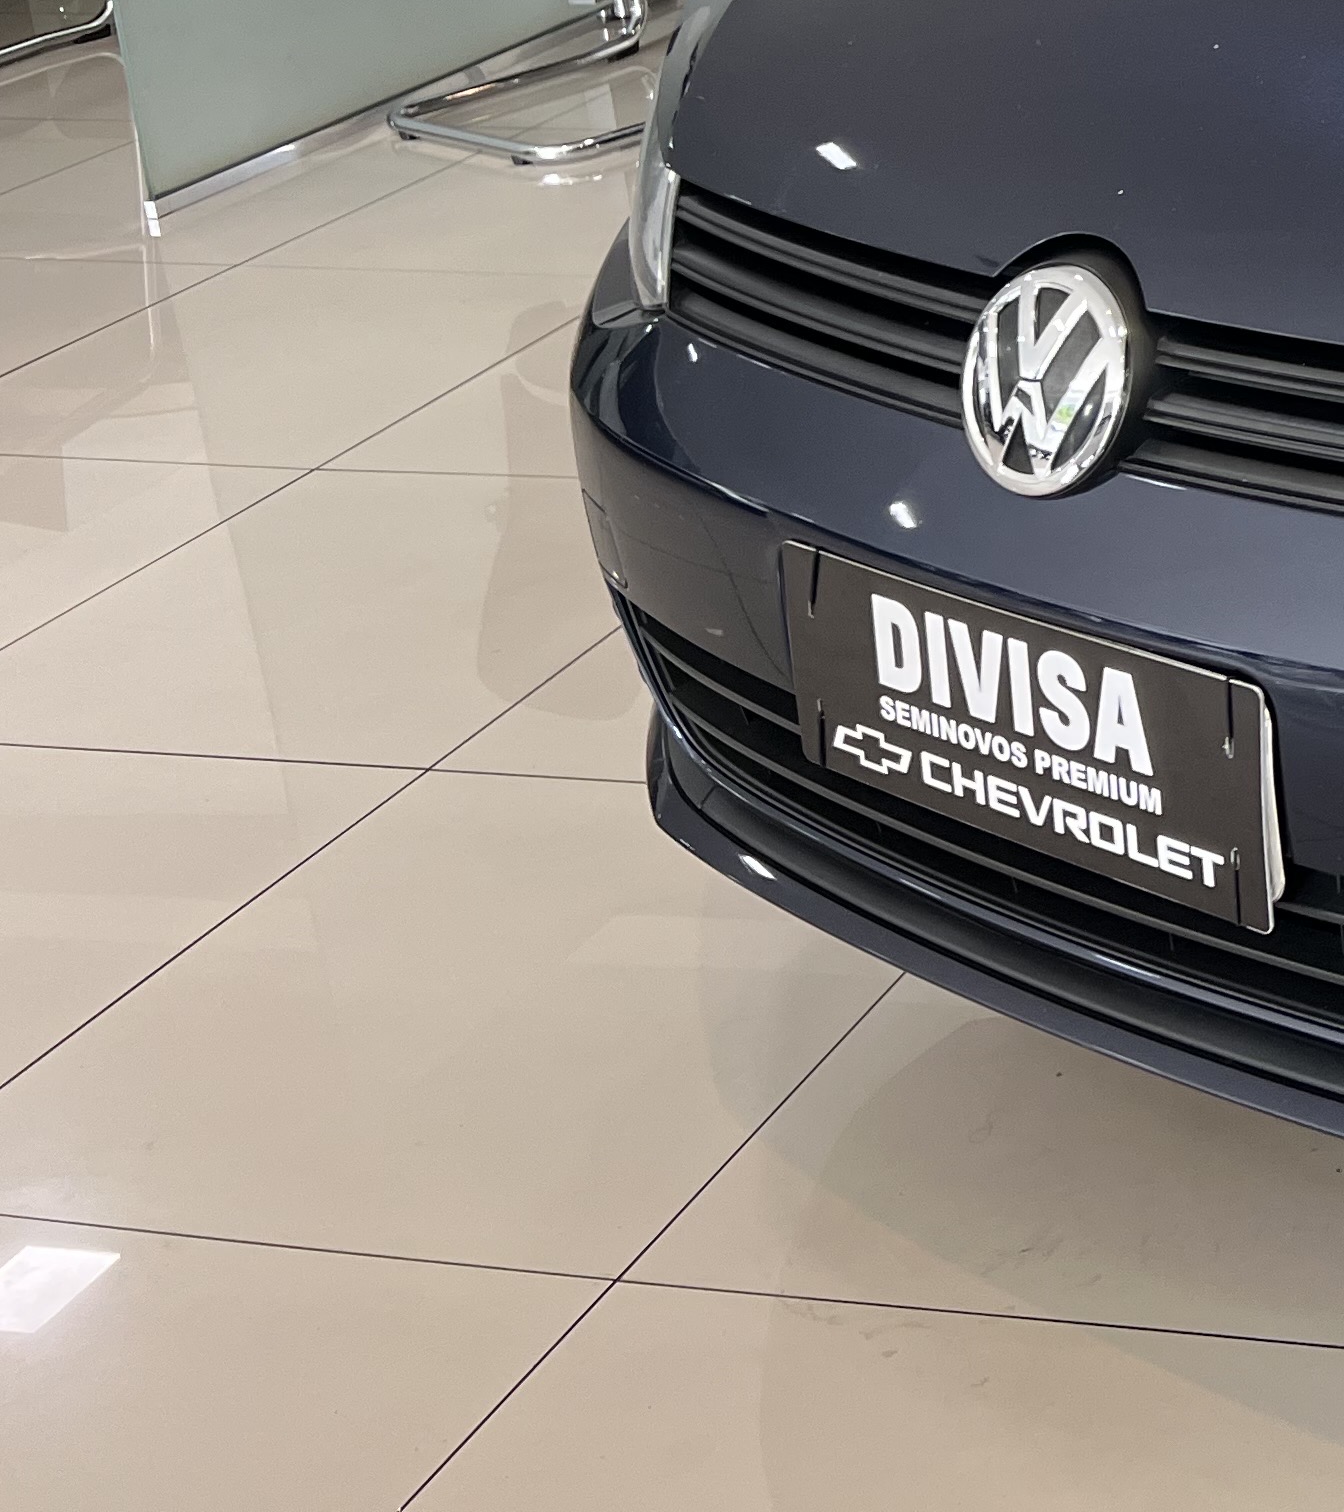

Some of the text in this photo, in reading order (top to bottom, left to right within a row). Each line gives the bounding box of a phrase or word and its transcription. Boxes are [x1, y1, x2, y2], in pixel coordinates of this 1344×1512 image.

[966, 267, 1129, 495] VW
[871, 593, 1154, 776] DIVISA
[879, 695, 1163, 816] SEMINOVOS PREMIUM
[919, 749, 1225, 888] CHEVROLET
